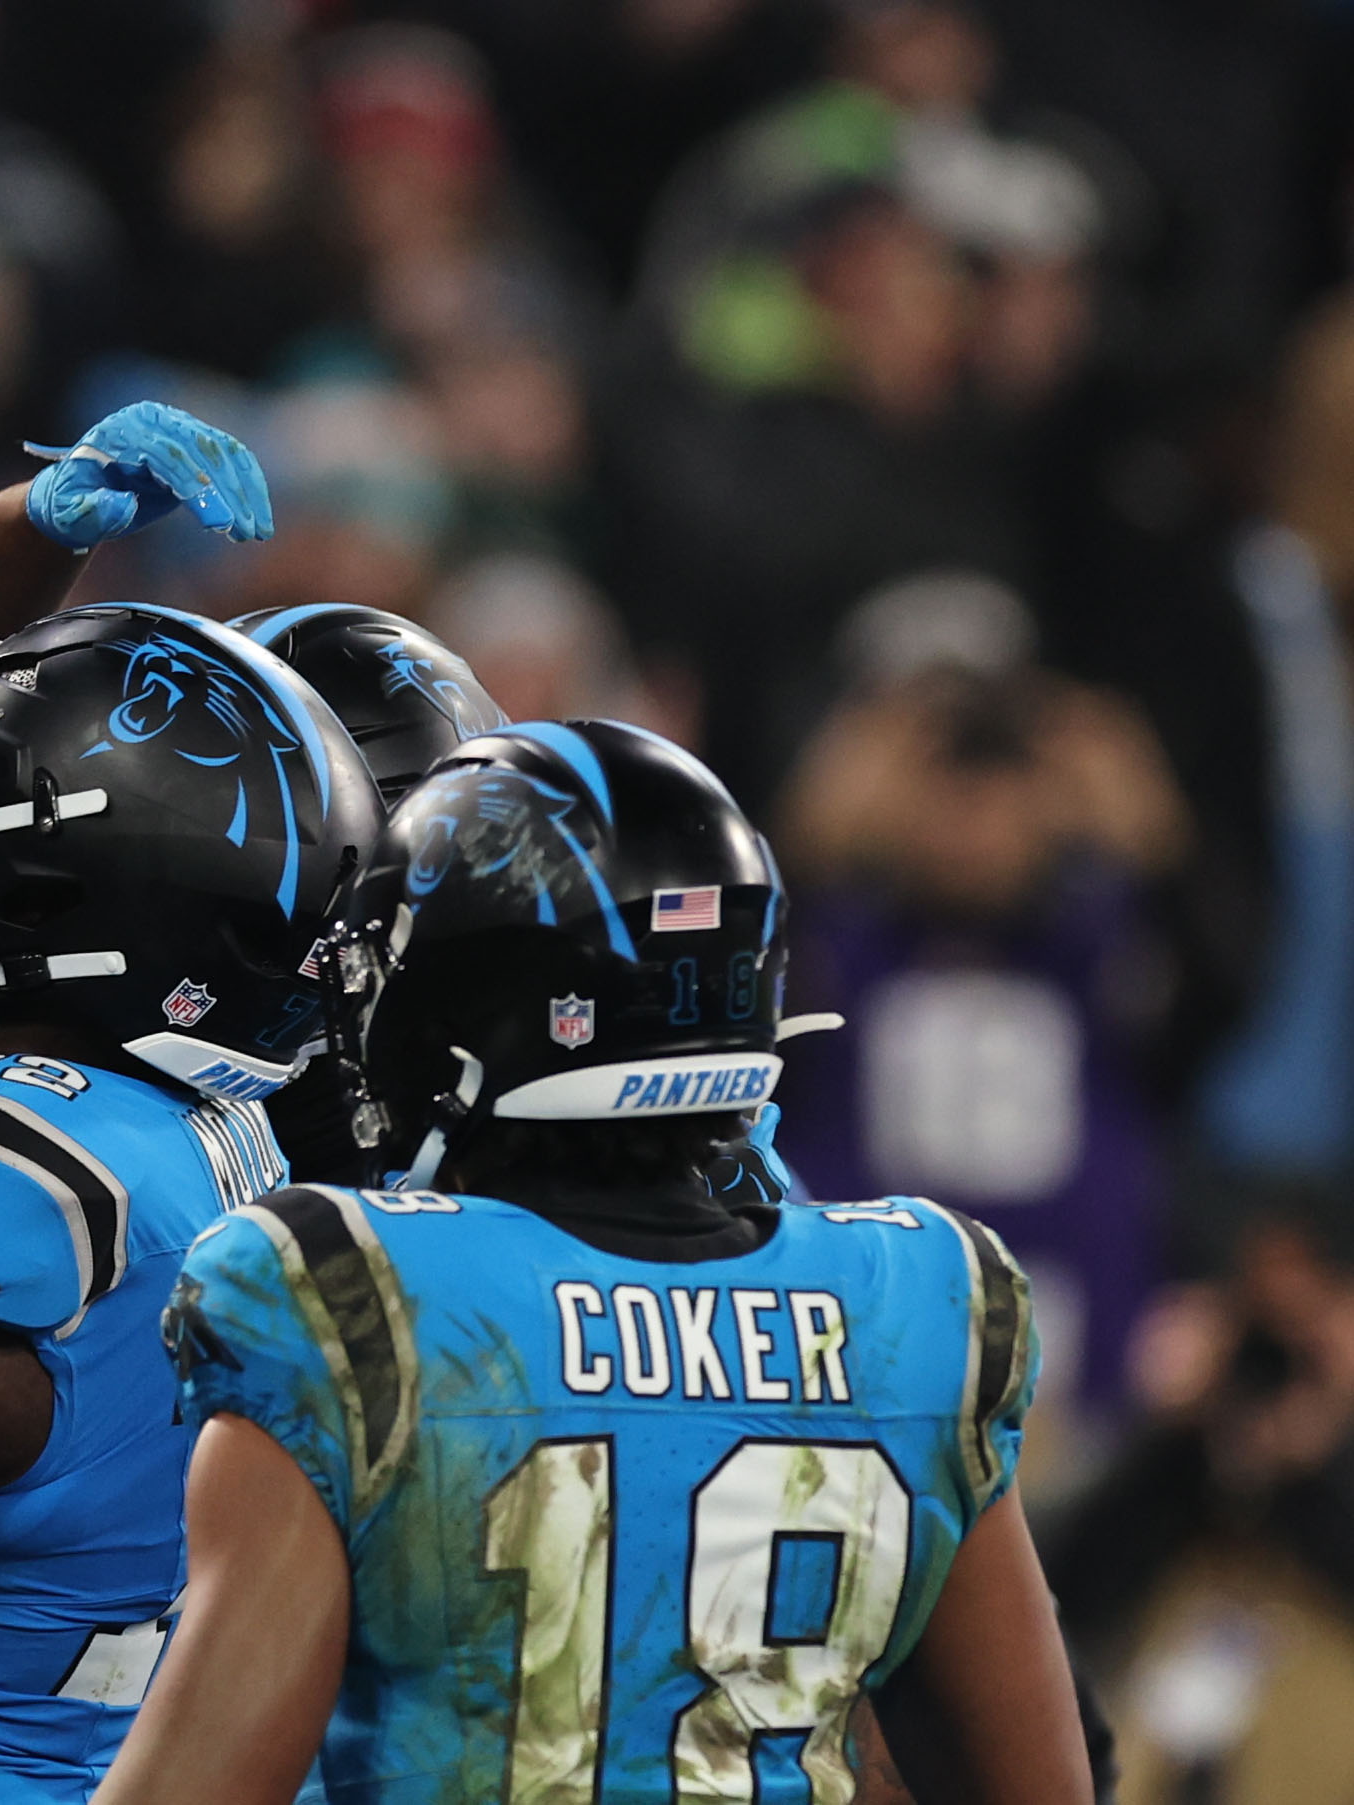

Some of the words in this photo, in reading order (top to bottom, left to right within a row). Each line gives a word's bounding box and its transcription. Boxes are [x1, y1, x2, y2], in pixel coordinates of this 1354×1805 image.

[167, 993, 199, 1023] NFL
[556, 1016, 590, 1038] NFL
[612, 1065, 771, 1110] PANTHERS
[554, 1280, 853, 1403] COKER
[480, 1434, 914, 1804] 18
